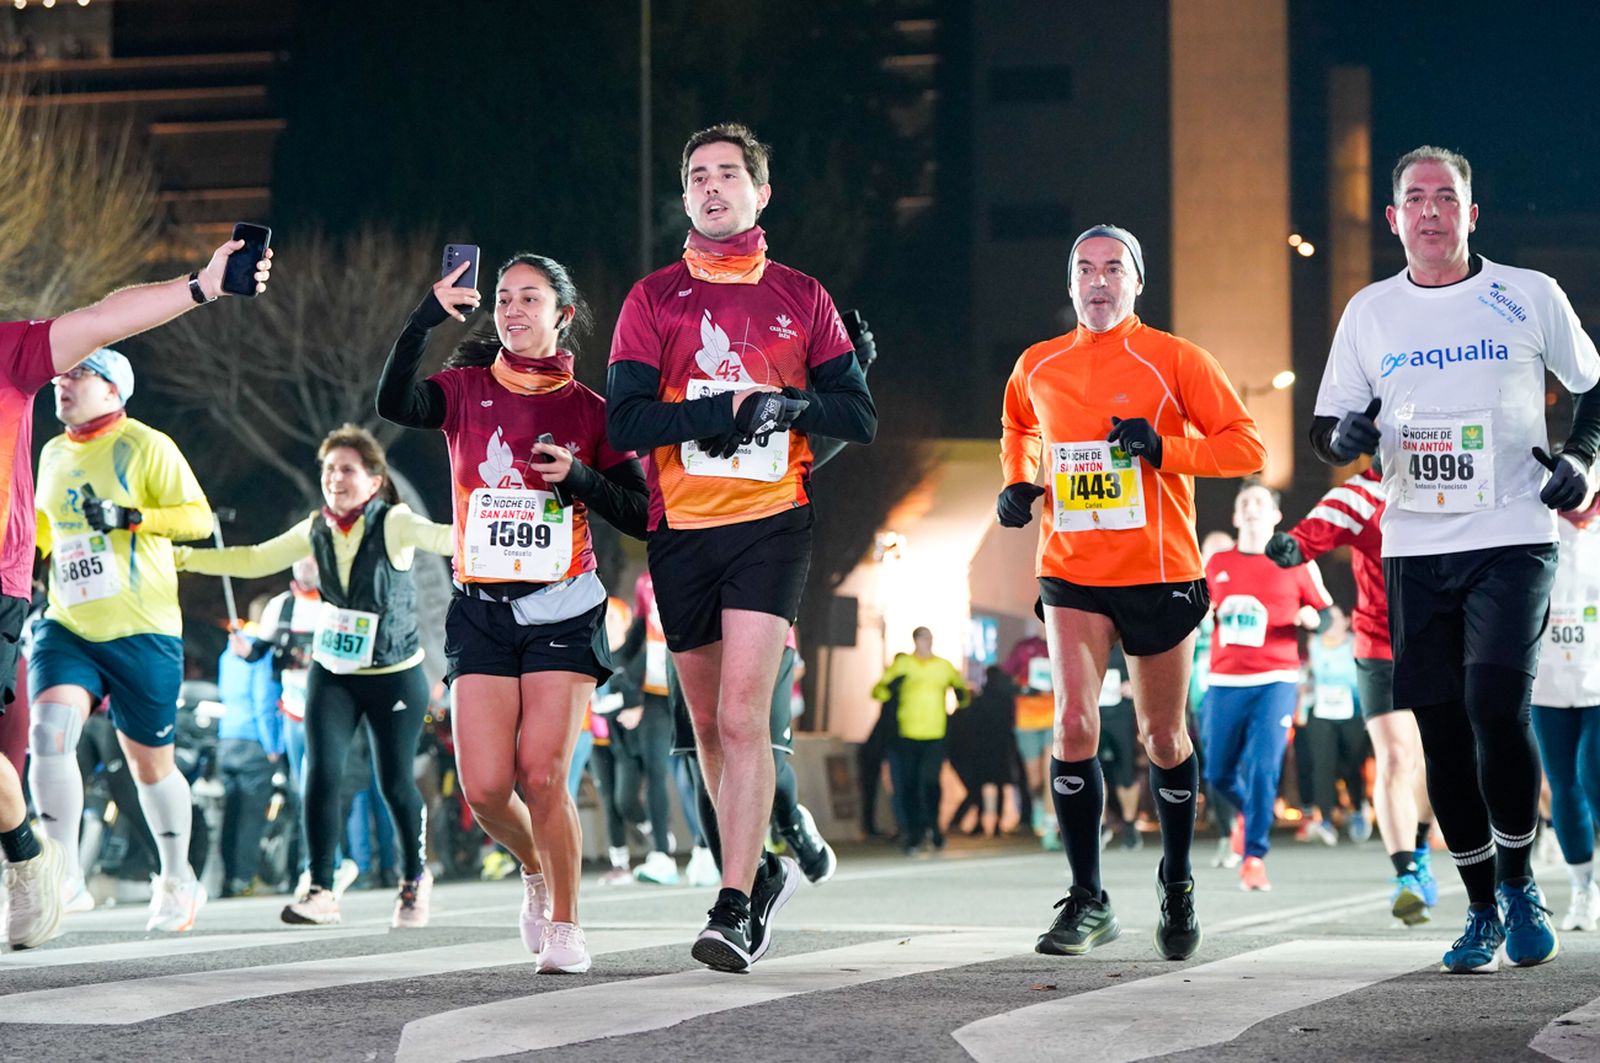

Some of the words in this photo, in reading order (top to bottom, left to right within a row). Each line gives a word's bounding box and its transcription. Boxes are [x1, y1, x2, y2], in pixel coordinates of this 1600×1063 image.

[1490, 290, 1527, 322] aqualia
[1410, 339, 1509, 370] aqualia
[715, 359, 741, 382] 43
[1410, 430, 1438, 440] NOCHE
[1440, 430, 1452, 440] DE
[1419, 440, 1453, 452] ANTÓN
[1091, 451, 1102, 460] DE
[1074, 461, 1103, 473] ANTÓN
[1409, 453, 1474, 481] 4998
[1438, 482, 1468, 490] Francisco
[493, 499, 523, 509] NOCHE
[524, 500, 537, 510] DE
[480, 510, 500, 519] SAN
[487, 520, 551, 549] 1599
[503, 549, 533, 557] Consuelo
[61, 555, 104, 583] 5885
[1551, 625, 1584, 644] 503
